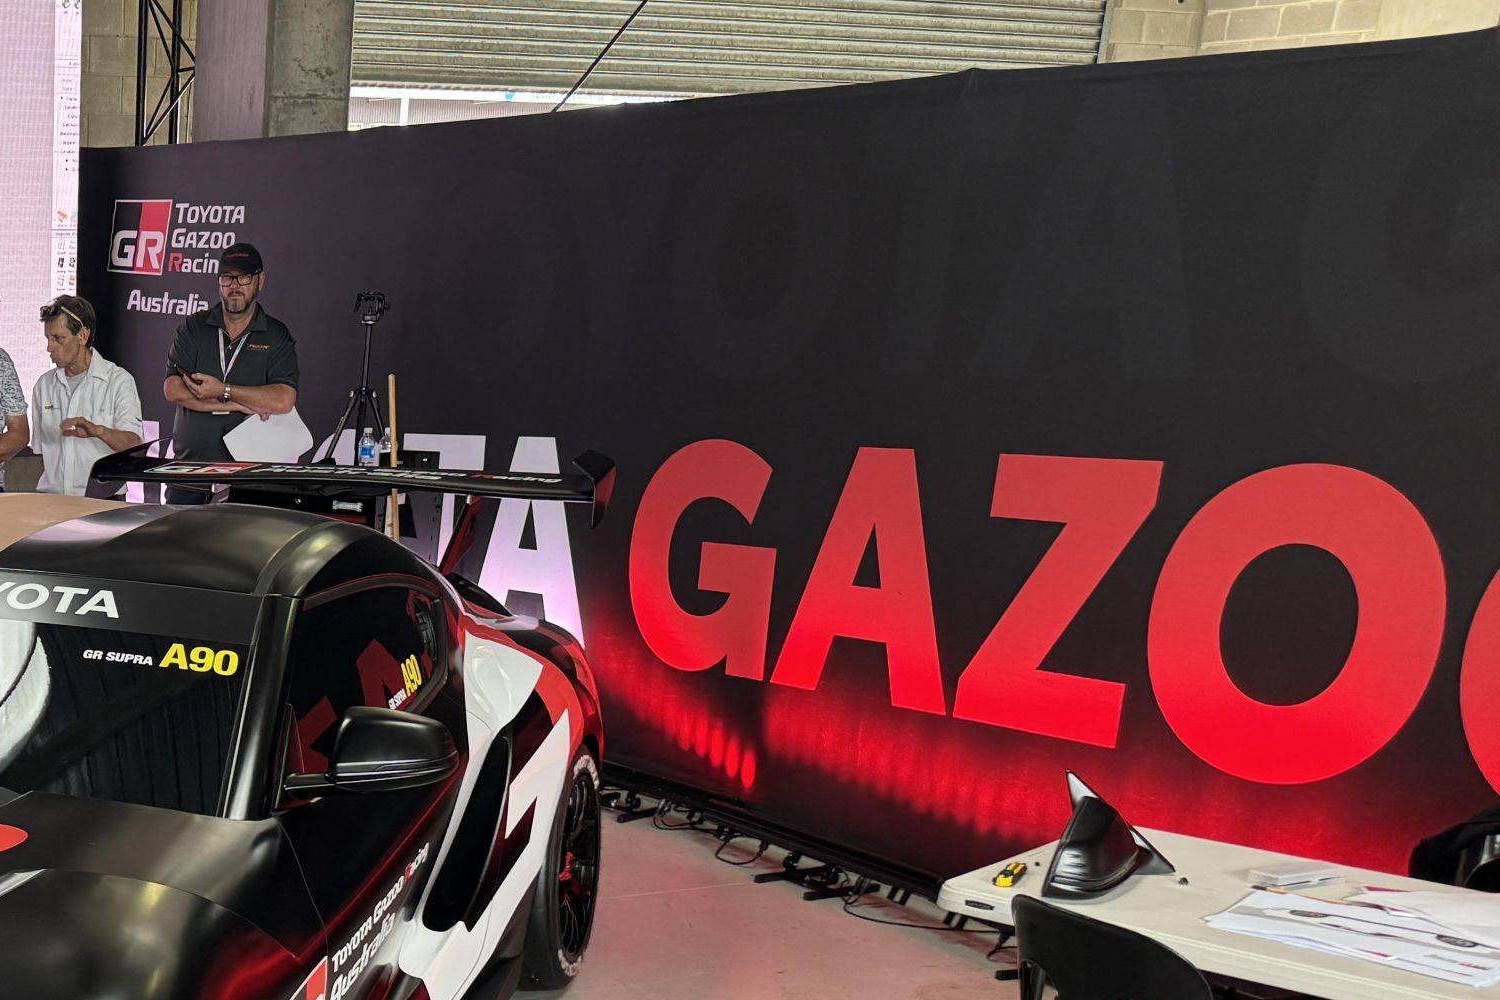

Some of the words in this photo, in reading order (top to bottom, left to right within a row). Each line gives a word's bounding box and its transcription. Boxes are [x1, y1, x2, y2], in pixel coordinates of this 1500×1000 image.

[175, 202, 245, 225] TOYOTA
[112, 230, 165, 269] GR
[171, 227, 236, 249] GAZOO
[168, 252, 220, 275] Racin
[127, 289, 209, 316] Australia
[628, 438, 1500, 800] GAZO
[82, 648, 105, 662] GR
[105, 650, 153, 667] SUPRA
[159, 643, 240, 677] A90
[400, 653, 422, 698] A90
[331, 915, 373, 973] TOYOTA
[372, 875, 405, 924] GAZOO
